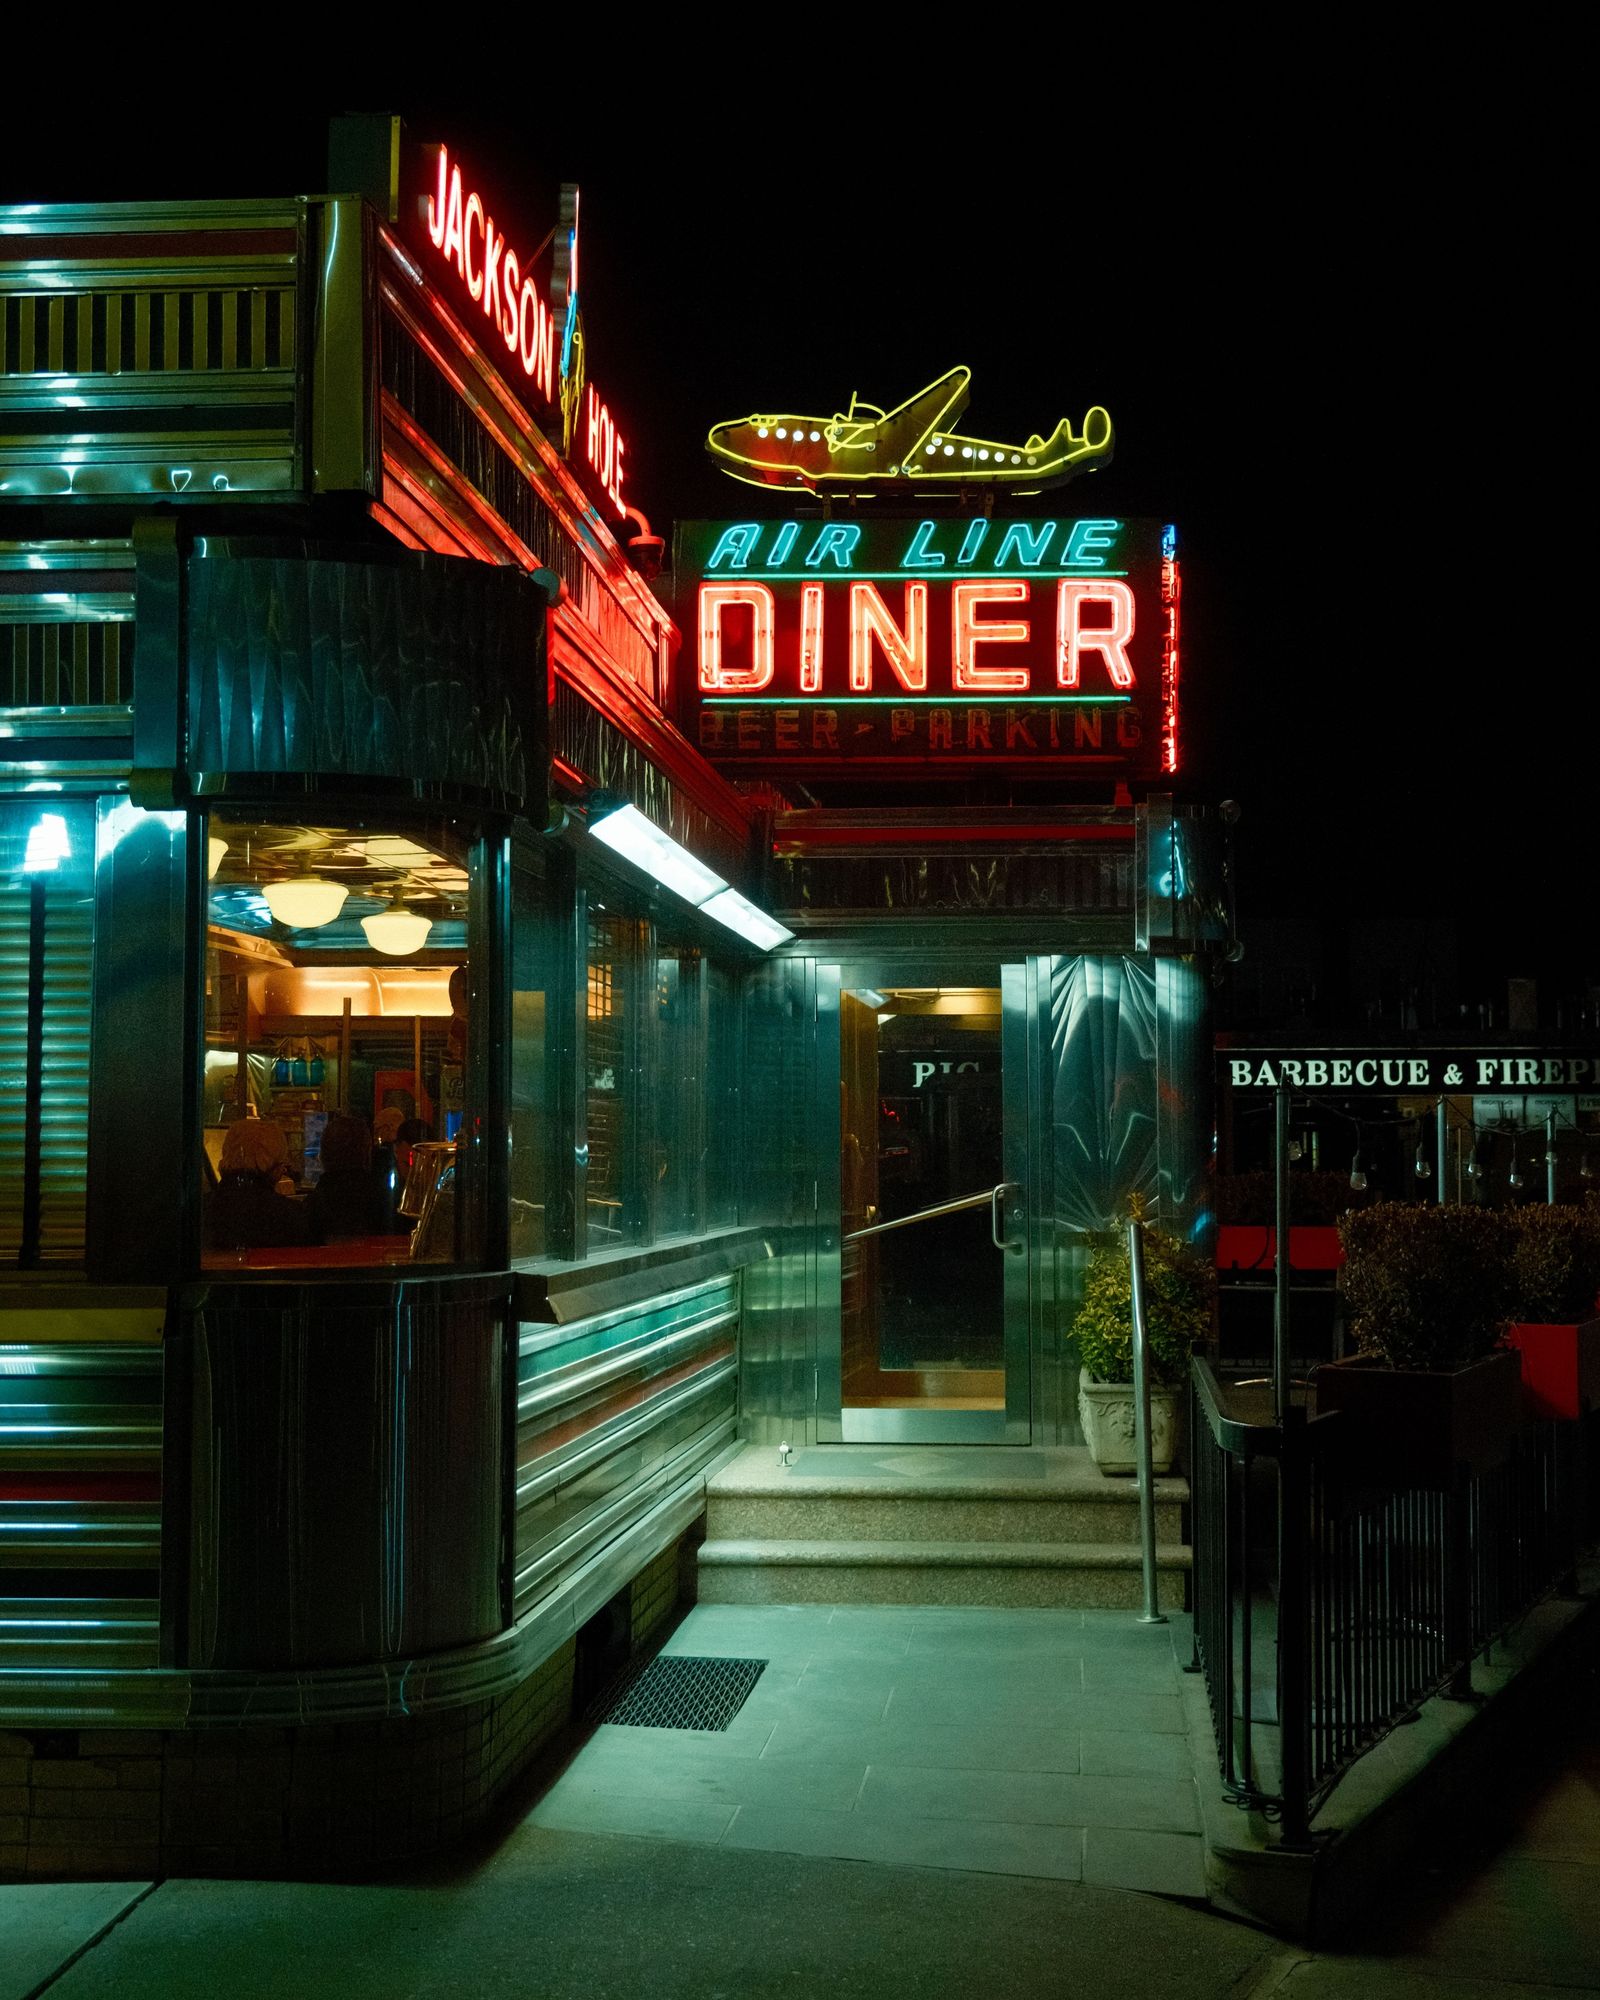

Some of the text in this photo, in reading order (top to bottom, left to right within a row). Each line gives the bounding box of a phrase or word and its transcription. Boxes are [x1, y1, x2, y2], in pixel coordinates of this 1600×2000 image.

[428, 143, 626, 519] JACKSON HOLE
[706, 518, 1121, 568] AIR LINE
[699, 579, 1136, 691] DINER
[889, 707, 1142, 749] PARKING
[1229, 1059, 1430, 1086] BARBECUE
[1443, 1063, 1464, 1086] &
